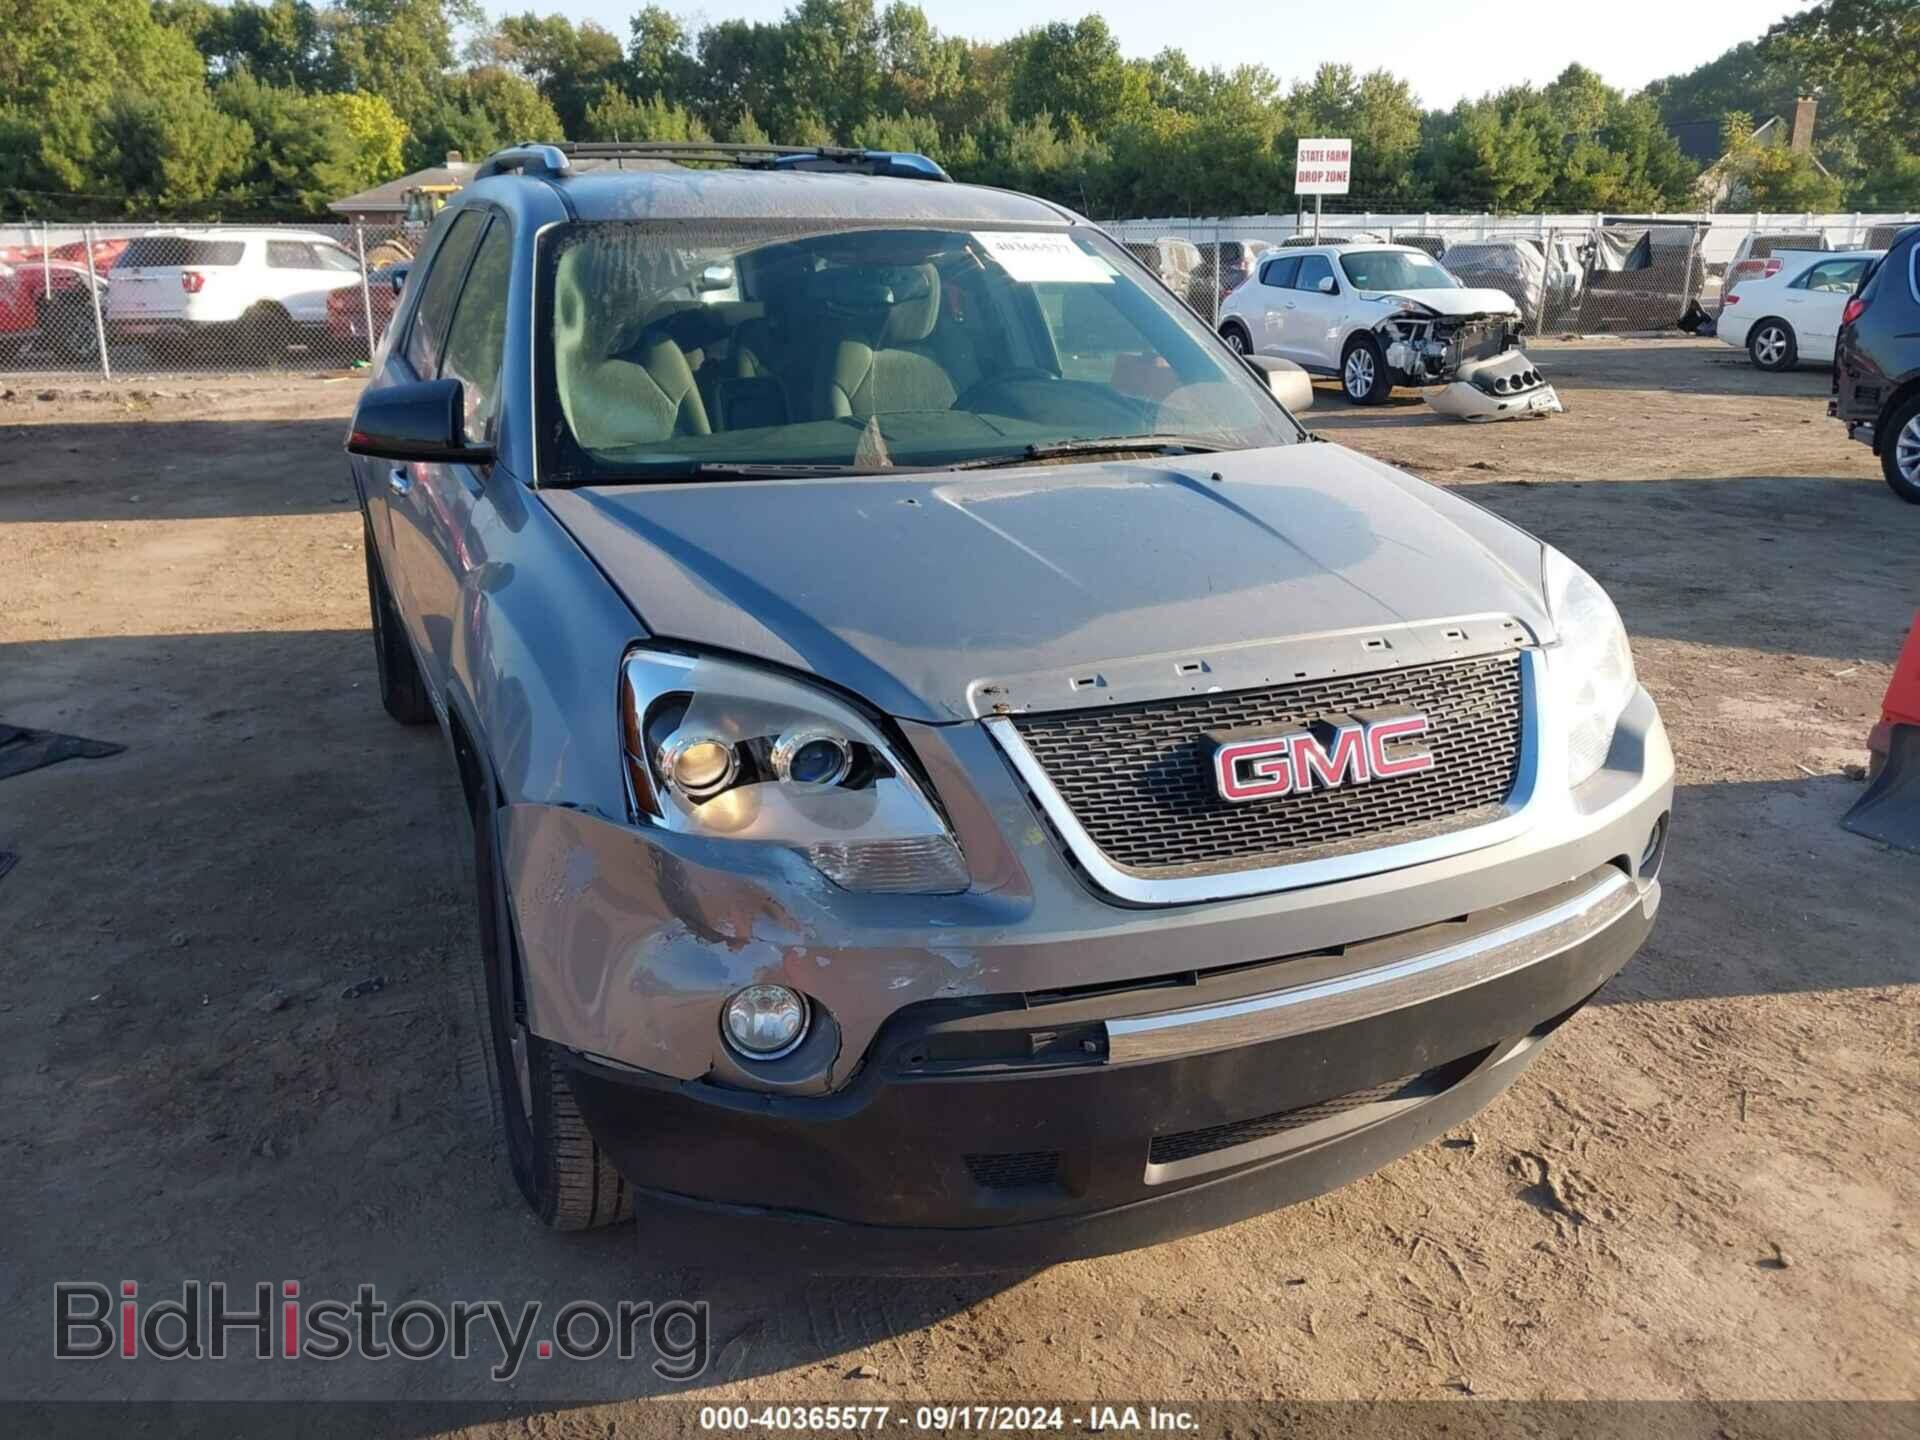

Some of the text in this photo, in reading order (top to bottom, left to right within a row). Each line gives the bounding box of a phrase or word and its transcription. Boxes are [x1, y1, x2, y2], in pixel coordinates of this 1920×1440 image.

[1300, 150, 1349, 162] STATE FARM
[1298, 171, 1347, 183] DROP ZONE
[1214, 715, 1434, 801] GMC
